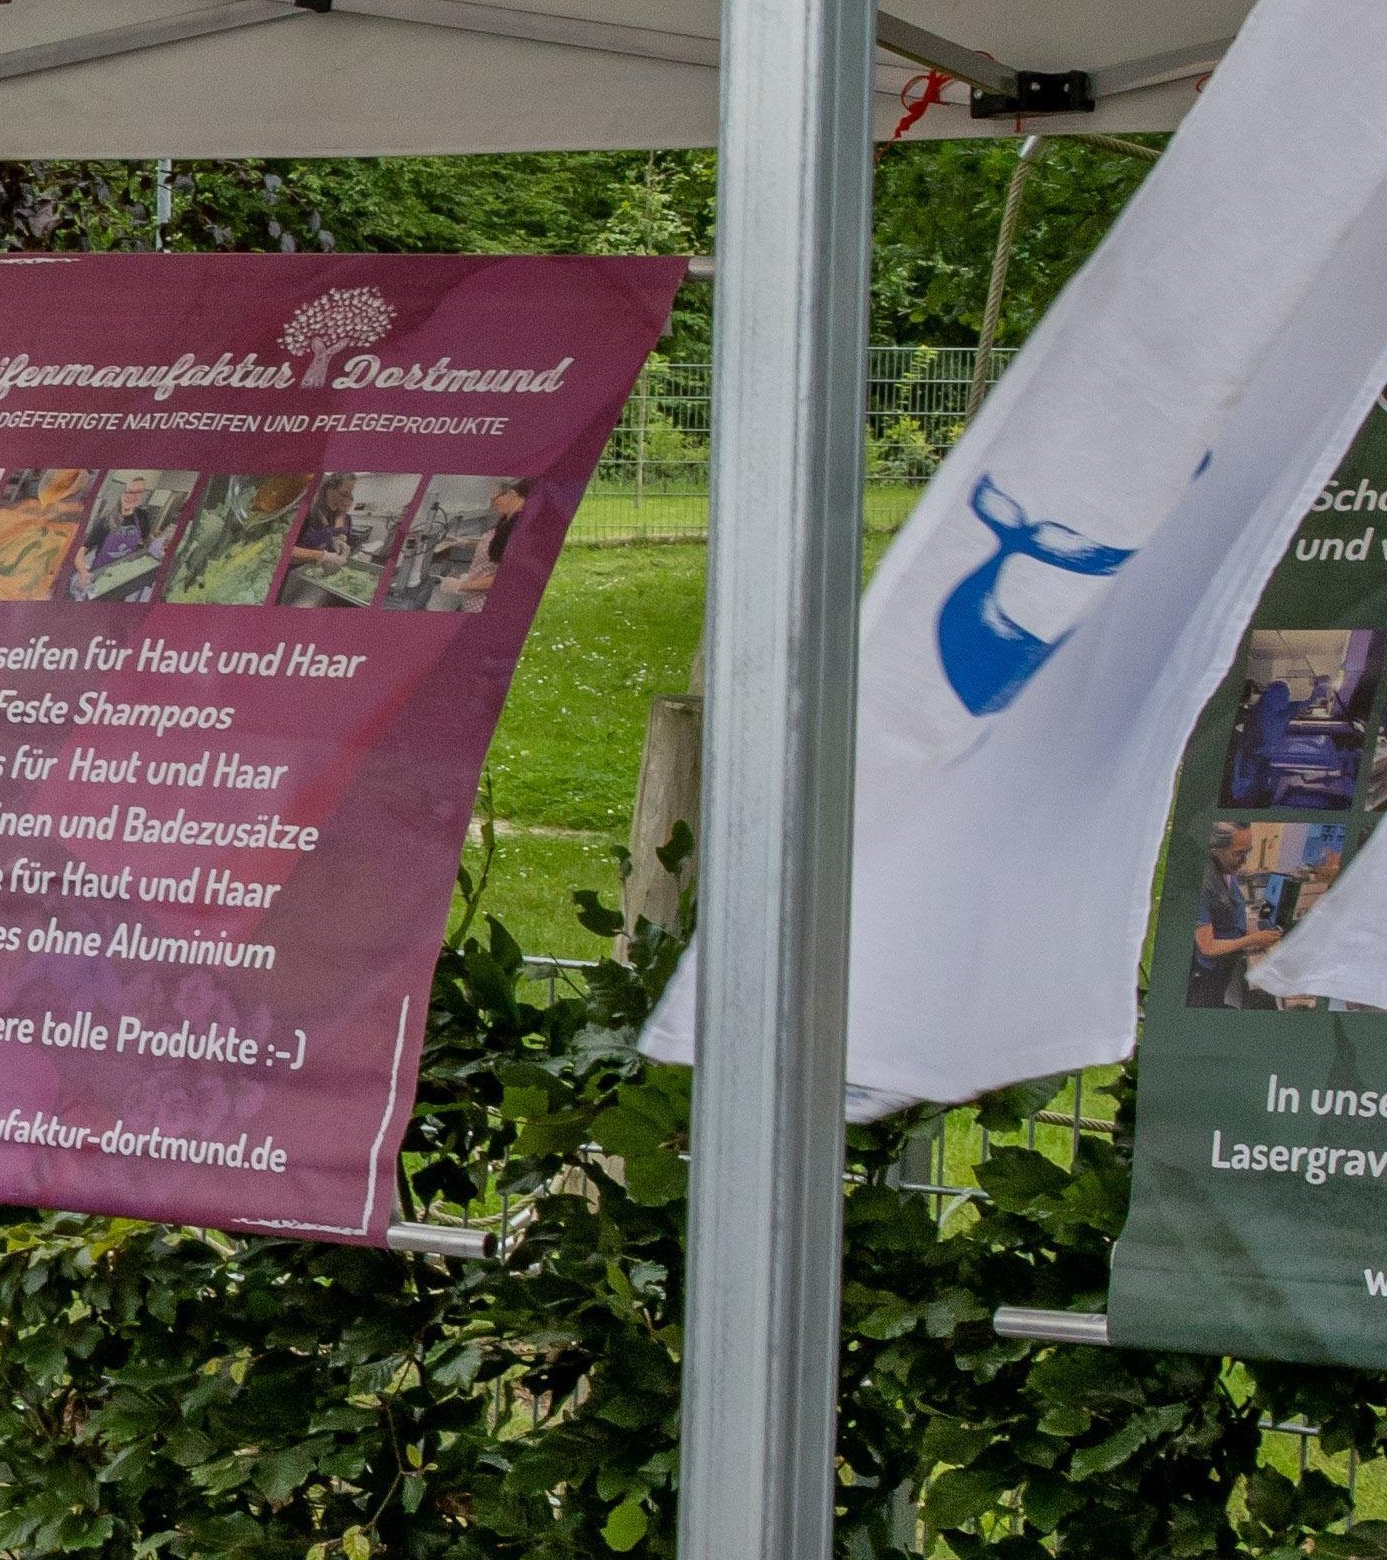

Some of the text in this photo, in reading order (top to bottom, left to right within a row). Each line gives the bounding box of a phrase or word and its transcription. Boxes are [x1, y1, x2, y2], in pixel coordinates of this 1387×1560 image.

[331, 354, 575, 394] Dortmund
[123, 412, 262, 434] NATURSEIFEN
[264, 413, 308, 434] UND
[310, 414, 509, 436] PFLEGEPRODUKTE
[1295, 526, 1375, 562] und
[82, 635, 134, 672] für
[136, 638, 213, 675] Haut
[217, 642, 285, 677] und
[285, 643, 366, 679] Haar
[72, 691, 236, 737] Shampoos
[10, 745, 58, 781] für
[68, 747, 142, 785] Haut
[146, 751, 211, 787] und
[213, 752, 289, 791] Haar
[58, 805, 120, 842] und
[122, 806, 319, 852] Badezusätze
[9, 858, 57, 895] für
[61, 861, 133, 901] Haut
[138, 868, 200, 905] und
[204, 869, 282, 908] Haar
[26, 918, 101, 957] ohne
[106, 922, 276, 969] Aluminium
[41, 1010, 108, 1052] tolle
[117, 1015, 259, 1066] Produkte
[1266, 1073, 1301, 1114] In
[1211, 1129, 1387, 1185] Lasergrav
